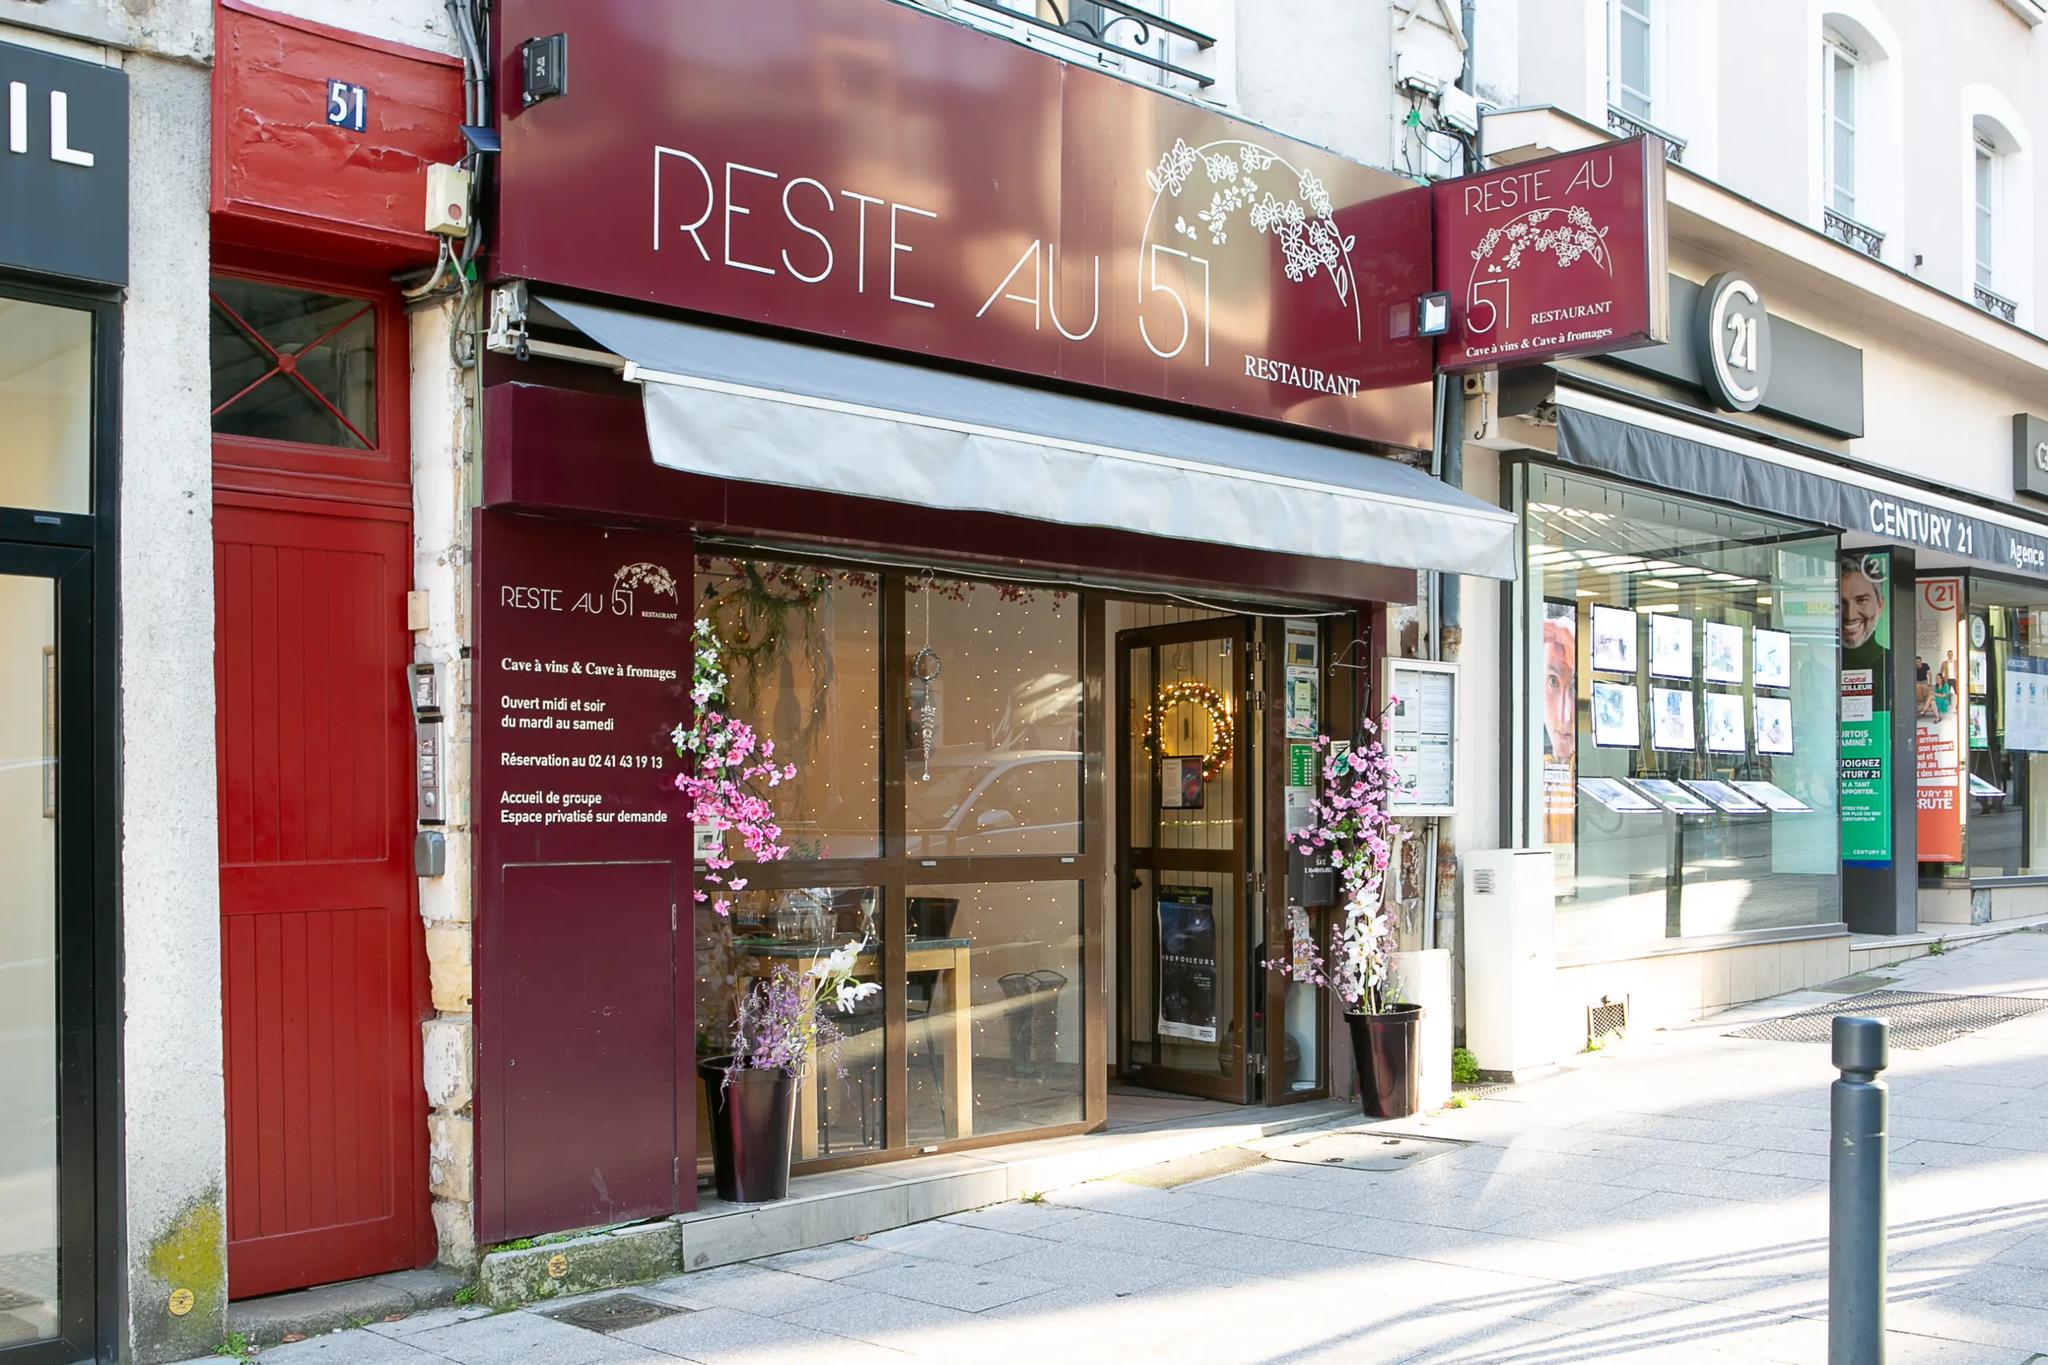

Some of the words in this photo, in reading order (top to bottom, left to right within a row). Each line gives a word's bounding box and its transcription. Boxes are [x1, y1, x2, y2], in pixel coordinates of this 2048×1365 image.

[329, 82, 364, 129] 51
[1465, 169, 1551, 216] RESTE
[1564, 155, 1613, 195] AU
[652, 144, 938, 309] RESTE
[976, 238, 1100, 341] AU
[1138, 243, 1210, 367] 51
[1466, 277, 1510, 334] 51
[1530, 301, 1612, 325] RESTAURANT
[1466, 347, 1490, 358] Cave
[1491, 343, 1498, 353] à
[1500, 341, 1519, 352] vins
[1520, 338, 1531, 349] &
[1532, 336, 1557, 348] Cave
[1558, 333, 1566, 343] à
[1567, 327, 1613, 342] fromages
[1244, 354, 1361, 399] RESTAURANT
[1869, 498, 1951, 549] CENTURY
[1957, 522, 1973, 555] 21
[2009, 537, 2045, 569] Agence
[501, 585, 563, 611] RESTE
[570, 592, 603, 614] AU
[611, 589, 634, 616] 51
[641, 610, 678, 620] RESTAURANT
[501, 657, 532, 671] Cave
[534, 658, 542, 672] à
[545, 660, 568, 674] vins
[571, 661, 583, 674] &
[585, 662, 615, 676] Cave
[616, 664, 624, 676] à
[626, 664, 677, 681] fromages
[1843, 676, 1866, 684] Capital
[501, 695, 540, 709] Ouvert
[542, 697, 568, 711] midi
[570, 699, 581, 711] et
[583, 699, 606, 712] soir
[501, 715, 516, 728] du
[519, 716, 553, 729] mardi
[555, 719, 570, 729] au
[572, 718, 614, 731] samedi
[501, 752, 570, 767] Réservation
[571, 756, 586, 767] au
[588, 754, 602, 767] 02
[603, 755, 616, 767] 41
[620, 755, 633, 767] 43
[635, 755, 648, 768] 19
[651, 756, 663, 769] 13
[1871, 770, 1880, 779] 21
[500, 791, 543, 804] Accueil
[545, 791, 560, 804] de
[562, 794, 602, 806] groupe
[1943, 789, 1953, 798] 21
[501, 810, 542, 825] Espace
[545, 809, 593, 825] privatisé
[596, 812, 615, 823] sur
[617, 810, 668, 823] demande
